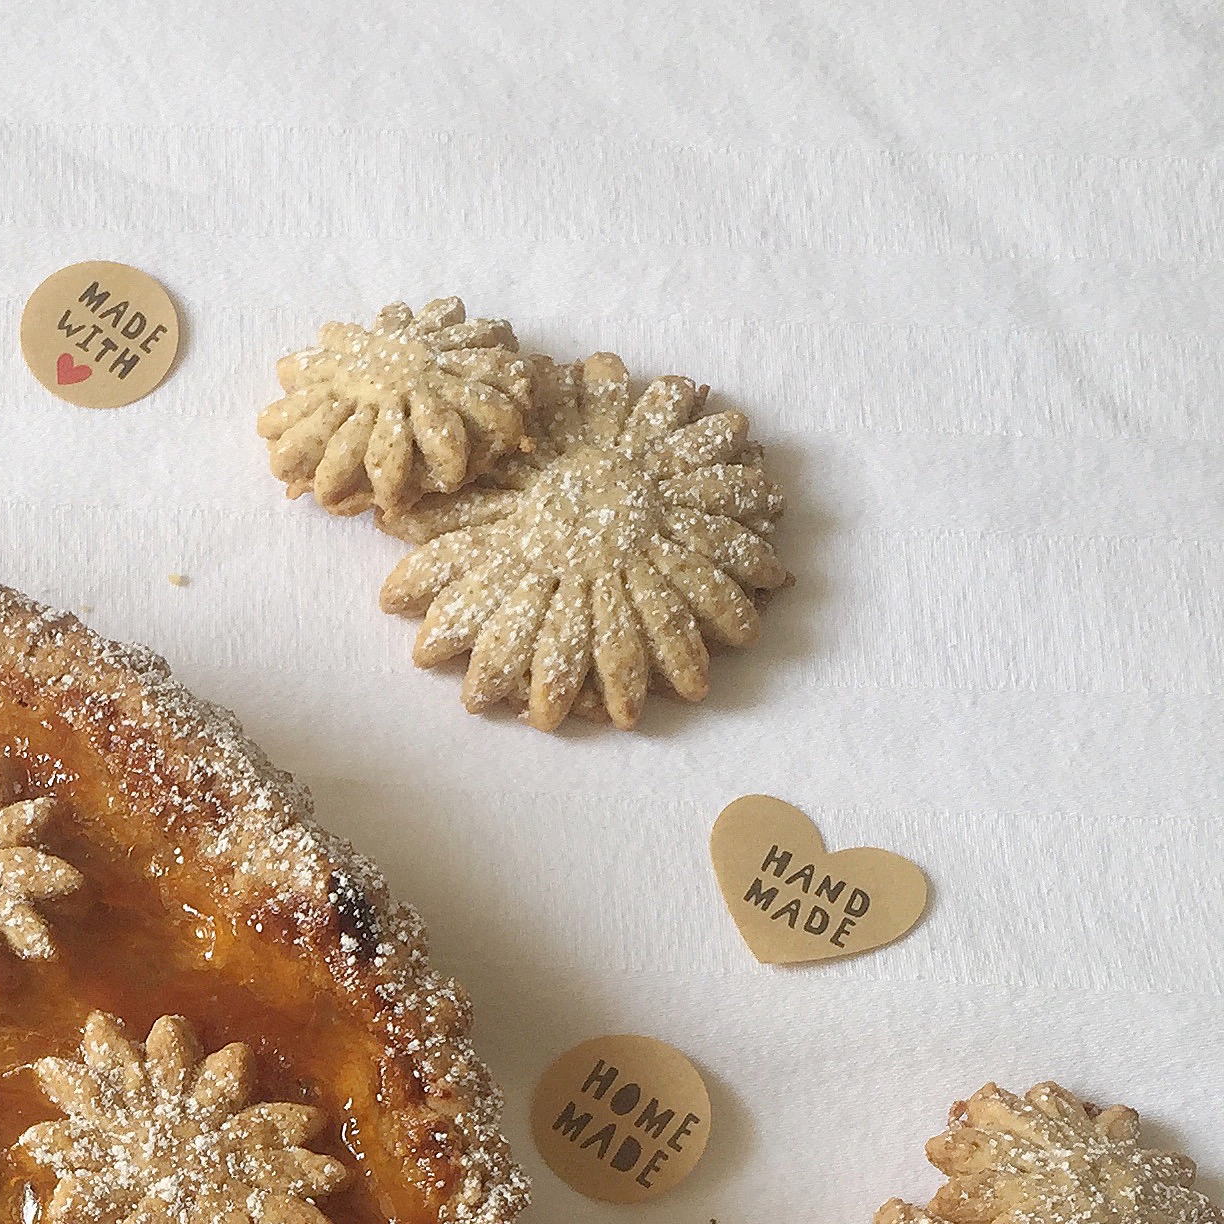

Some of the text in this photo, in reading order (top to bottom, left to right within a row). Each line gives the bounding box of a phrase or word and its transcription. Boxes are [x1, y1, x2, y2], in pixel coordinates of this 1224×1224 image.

[57, 309, 141, 380] WITH
[78, 281, 168, 354] MADE
[743, 877, 856, 948] MADE
[761, 845, 871, 918] HAND
[581, 1059, 700, 1152] HOME
[552, 1101, 669, 1189] MADE
